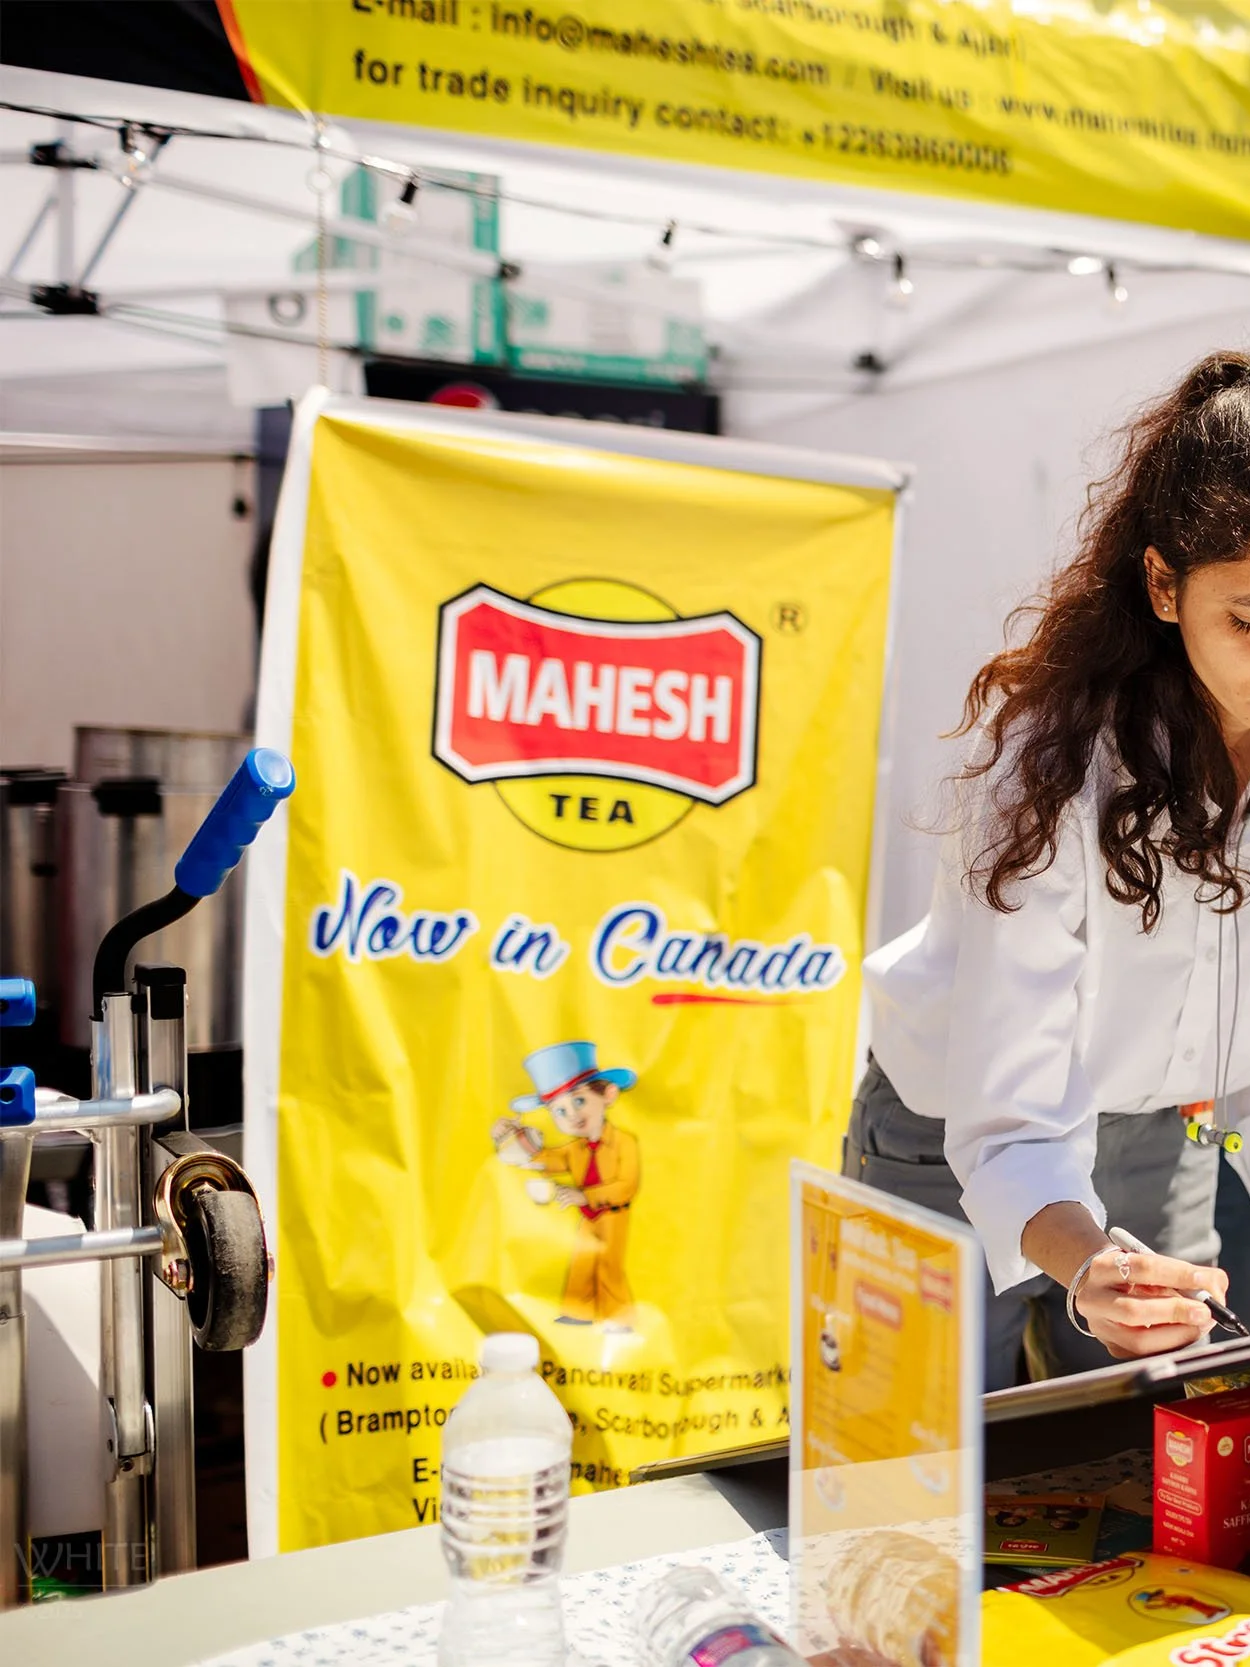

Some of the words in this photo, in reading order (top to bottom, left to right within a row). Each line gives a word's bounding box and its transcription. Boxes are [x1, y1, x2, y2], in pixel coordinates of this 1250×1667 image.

[353, 49, 404, 87] for
[419, 60, 510, 104] trade
[522, 77, 643, 130] inquiry
[467, 650, 733, 743] MAHESH
[551, 792, 636, 826] TEA
[312, 872, 476, 960] Now
[491, 914, 569, 978] in
[594, 900, 846, 991] Canada
[347, 1362, 401, 1387] Now
[658, 1363, 790, 1397] Supermark
[596, 1408, 738, 1440] Scarborough
[750, 1408, 764, 1428] &
